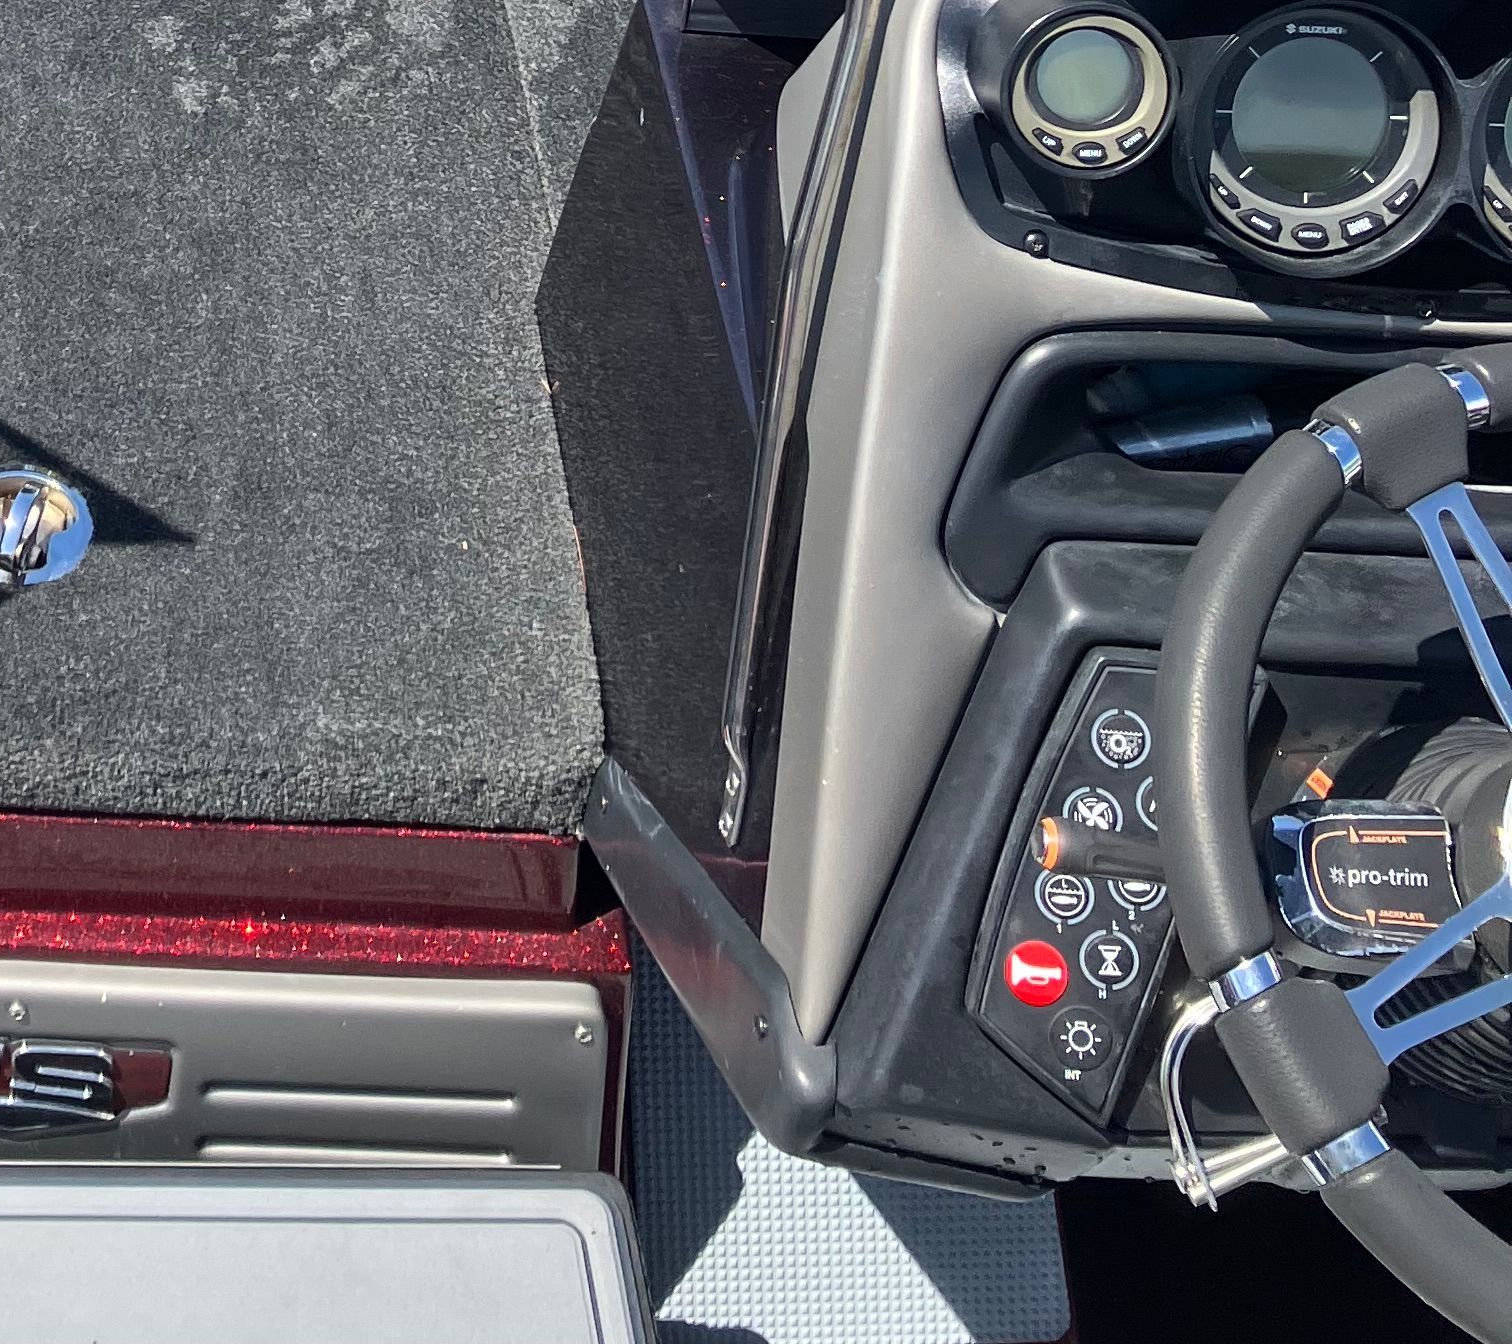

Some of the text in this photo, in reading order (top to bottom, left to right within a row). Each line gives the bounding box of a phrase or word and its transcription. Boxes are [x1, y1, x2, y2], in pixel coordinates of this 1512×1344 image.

[1298, 25, 1343, 35] SUZUKI
[1042, 135, 1057, 147] UP
[1079, 149, 1102, 158] MENU
[1297, 229, 1323, 240] MENU
[1347, 867, 1429, 888] pro-trim
[1064, 1069, 1082, 1081] INT
